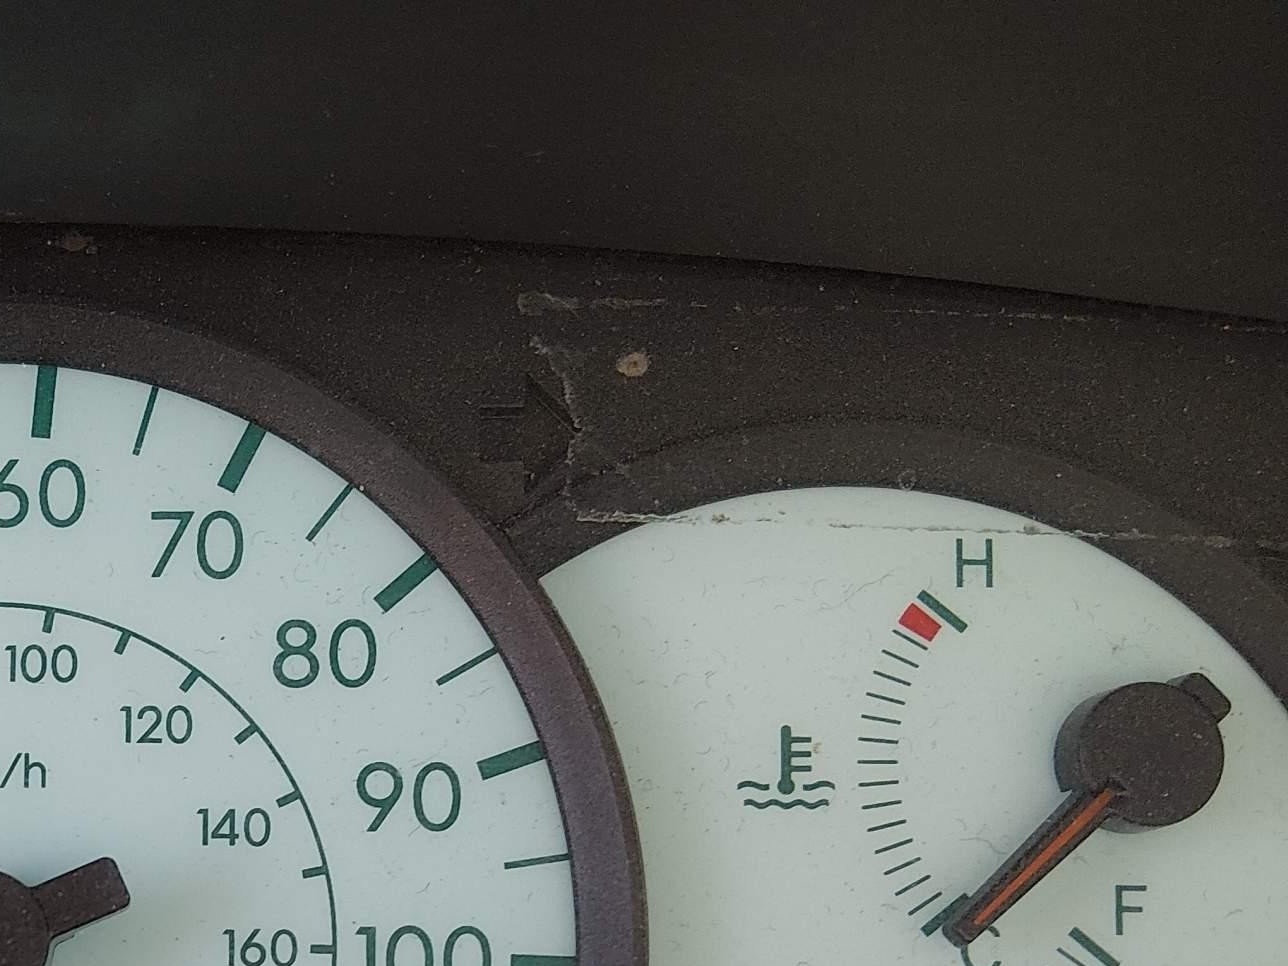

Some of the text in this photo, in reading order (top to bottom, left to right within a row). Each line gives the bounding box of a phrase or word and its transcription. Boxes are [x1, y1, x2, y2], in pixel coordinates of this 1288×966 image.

[150, 510, 244, 579] 70
[956, 538, 993, 588] H
[4, 643, 78, 683] 100
[272, 618, 377, 688] 80
[119, 705, 193, 745] 120
[355, 761, 462, 833] 90
[196, 807, 271, 847] 140
[1115, 885, 1147, 936] F
